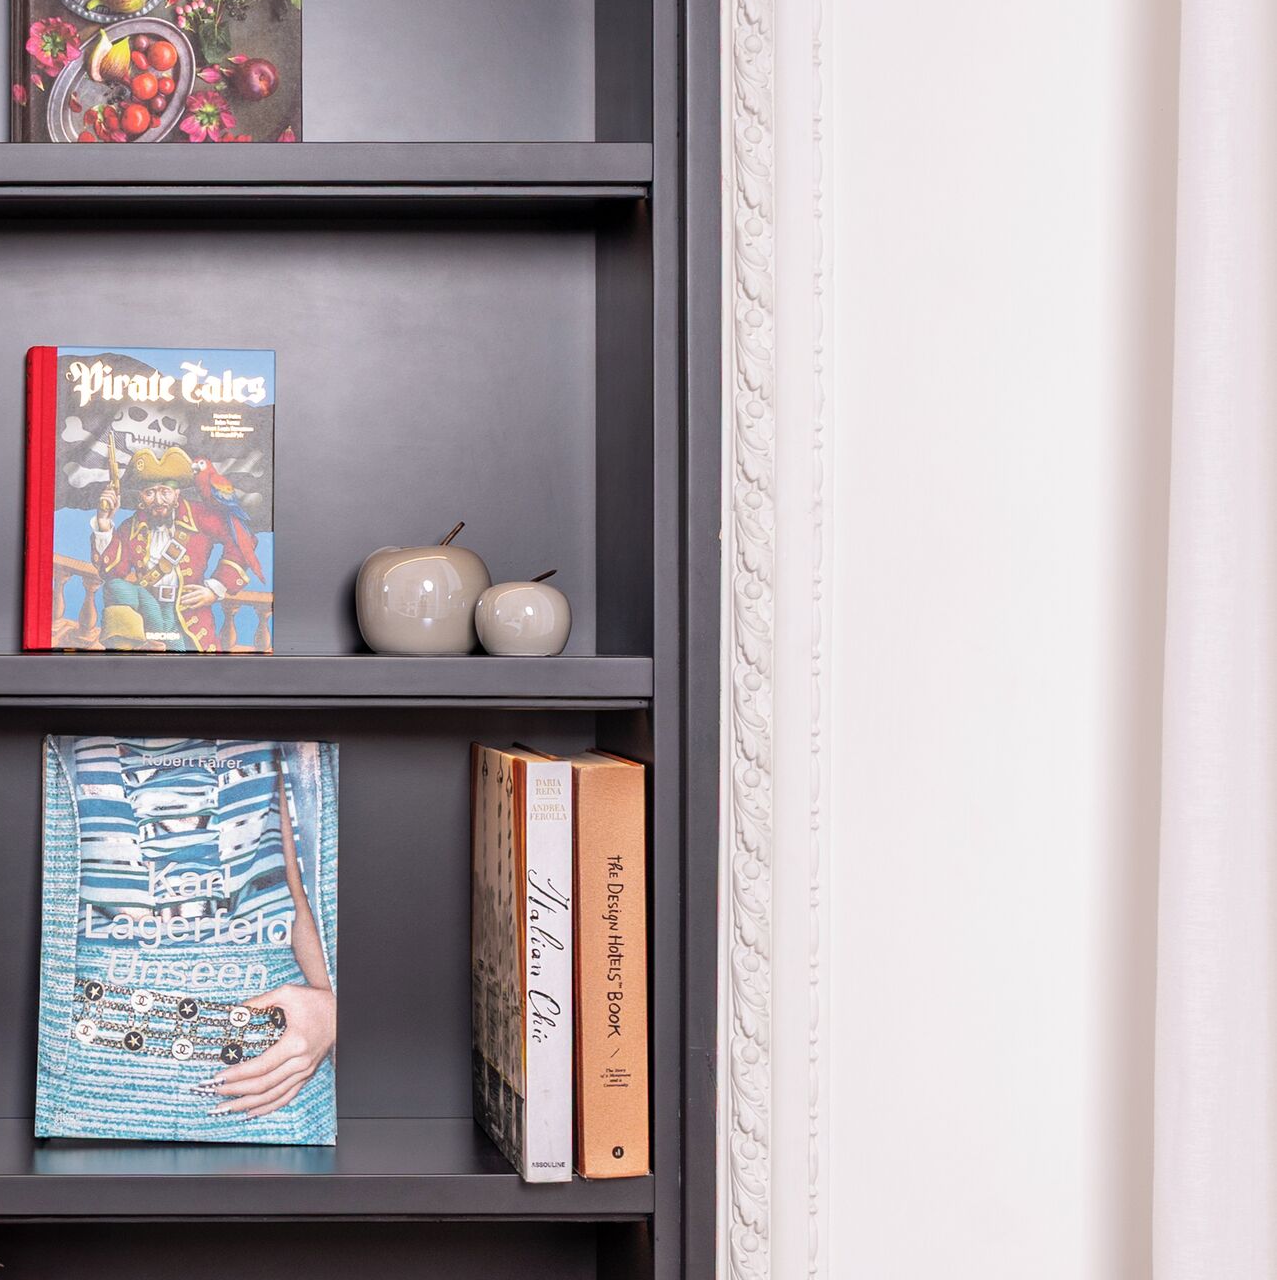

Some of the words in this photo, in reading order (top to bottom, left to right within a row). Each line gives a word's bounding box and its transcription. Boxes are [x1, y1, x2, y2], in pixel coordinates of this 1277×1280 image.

[65, 360, 175, 407] Pirate
[180, 360, 267, 405] Tales
[143, 753, 194, 768] Robert
[198, 755, 243, 769] Fairer
[535, 779, 562, 787] DARIA
[535, 787, 562, 795] REINA
[531, 803, 566, 812] ANDREA
[146, 861, 231, 898] Karl
[85, 903, 293, 949] Lagerfeld
[527, 869, 570, 976] Italian
[107, 950, 268, 990] Unseen
[527, 989, 561, 1043] Chic
